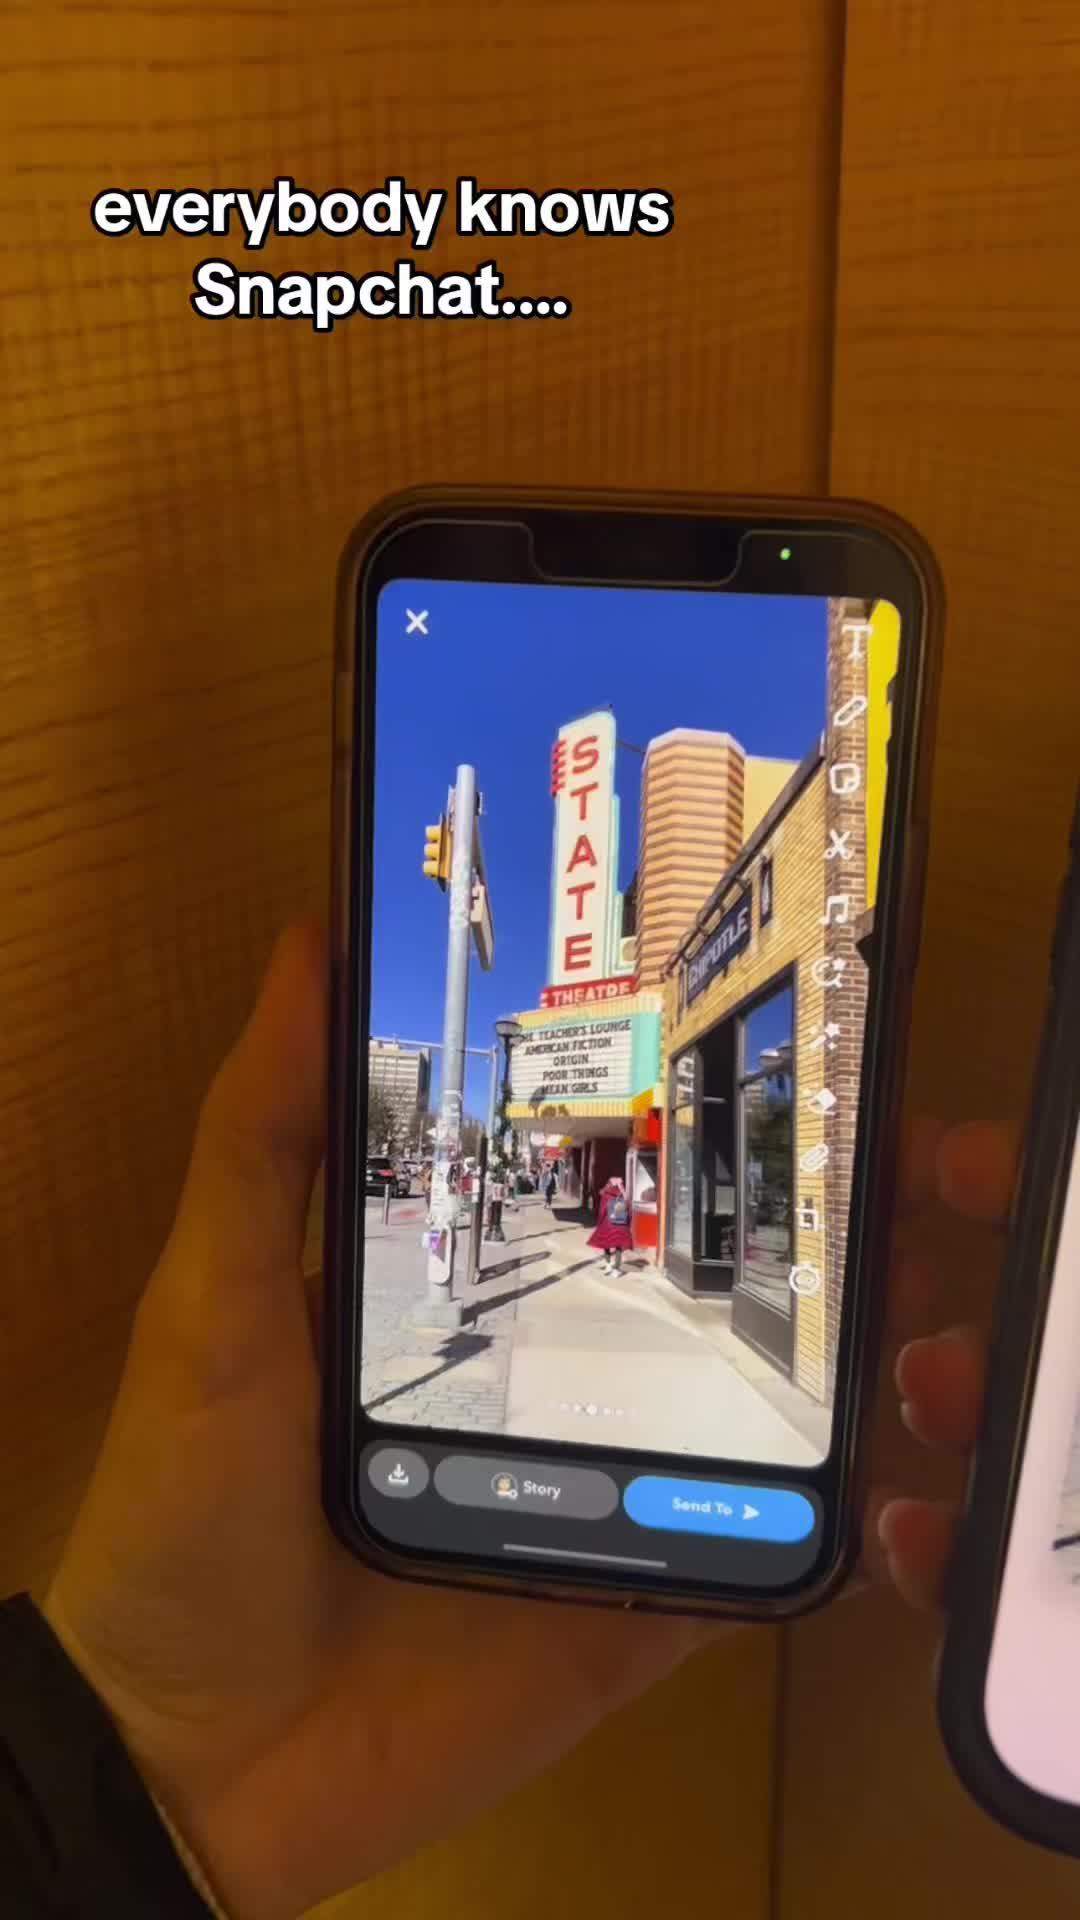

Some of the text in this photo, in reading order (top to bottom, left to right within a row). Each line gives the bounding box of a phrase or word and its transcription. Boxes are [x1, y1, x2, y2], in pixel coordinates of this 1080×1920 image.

[563, 735, 600, 972] STATE
[553, 982, 631, 1006] THEATRE
[591, 1019, 631, 1034] LOUNGE
[525, 1037, 612, 1055] AMERICAN FICTION
[553, 1053, 590, 1066] ORIGIN
[543, 1067, 608, 1081] POOR THINGS
[542, 1082, 598, 1095] MEAN GIRLS
[523, 1480, 562, 1500] Story
[672, 1497, 733, 1516] Send To
